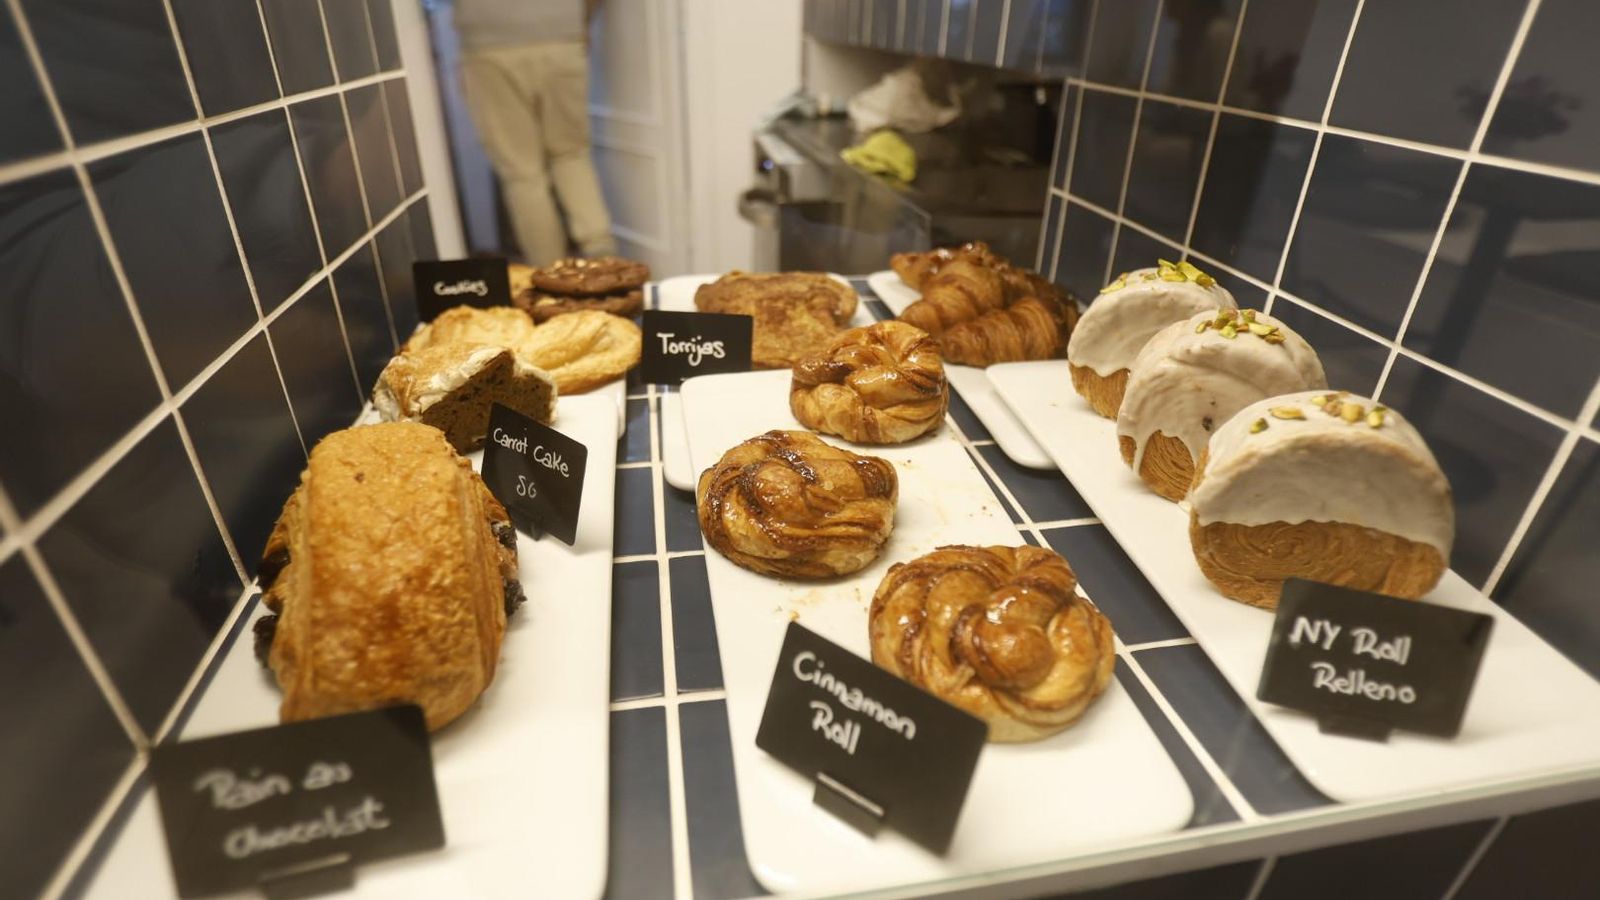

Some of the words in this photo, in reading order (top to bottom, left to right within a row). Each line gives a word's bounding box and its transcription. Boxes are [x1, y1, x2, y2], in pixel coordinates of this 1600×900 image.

[434, 280, 489, 297] Cookies
[656, 332, 726, 367] Torrijas
[493, 428, 528, 454] Carrot
[533, 445, 570, 478] Cake
[1288, 616, 1342, 650] NY
[1350, 628, 1412, 665] Roll
[793, 651, 917, 740] Cinnamon
[1310, 661, 1416, 704] Relleno
[809, 701, 861, 755] Roll
[195, 768, 292, 810] Pain
